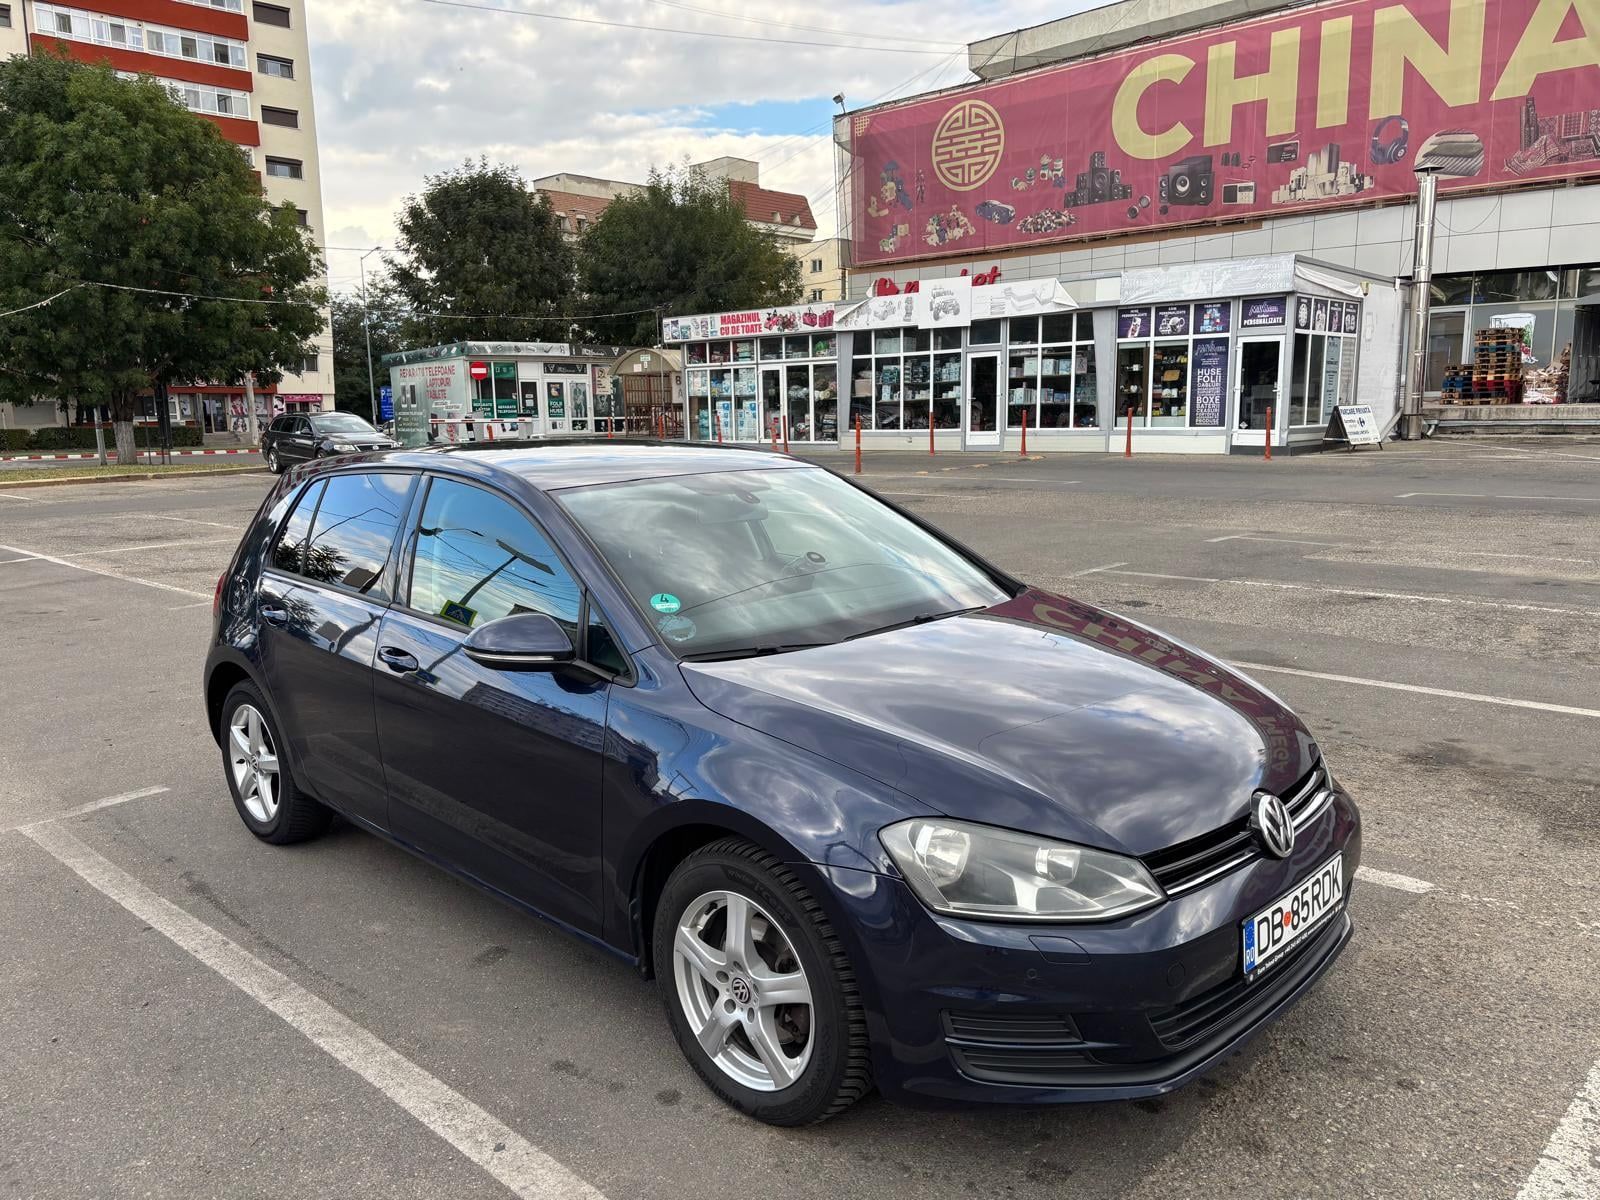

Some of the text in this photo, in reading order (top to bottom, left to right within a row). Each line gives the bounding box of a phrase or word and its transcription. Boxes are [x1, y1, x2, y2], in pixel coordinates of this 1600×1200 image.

[1112, 0, 1600, 160] CHINA
[720, 312, 761, 325] MAGAZINUL
[1243, 316, 1283, 326] PERSONALIZATE
[720, 323, 763, 336] CU DE TOATE
[425, 364, 456, 377] TELEFOANE
[1197, 368, 1222, 376] HUSE
[1197, 375, 1222, 383] FOLII
[1196, 396, 1220, 404] BOXE
[660, 594, 670, 603] 4
[1257, 906, 1283, 957] DB
[1291, 859, 1341, 931] 85RDK
[1246, 947, 1255, 966] RO
